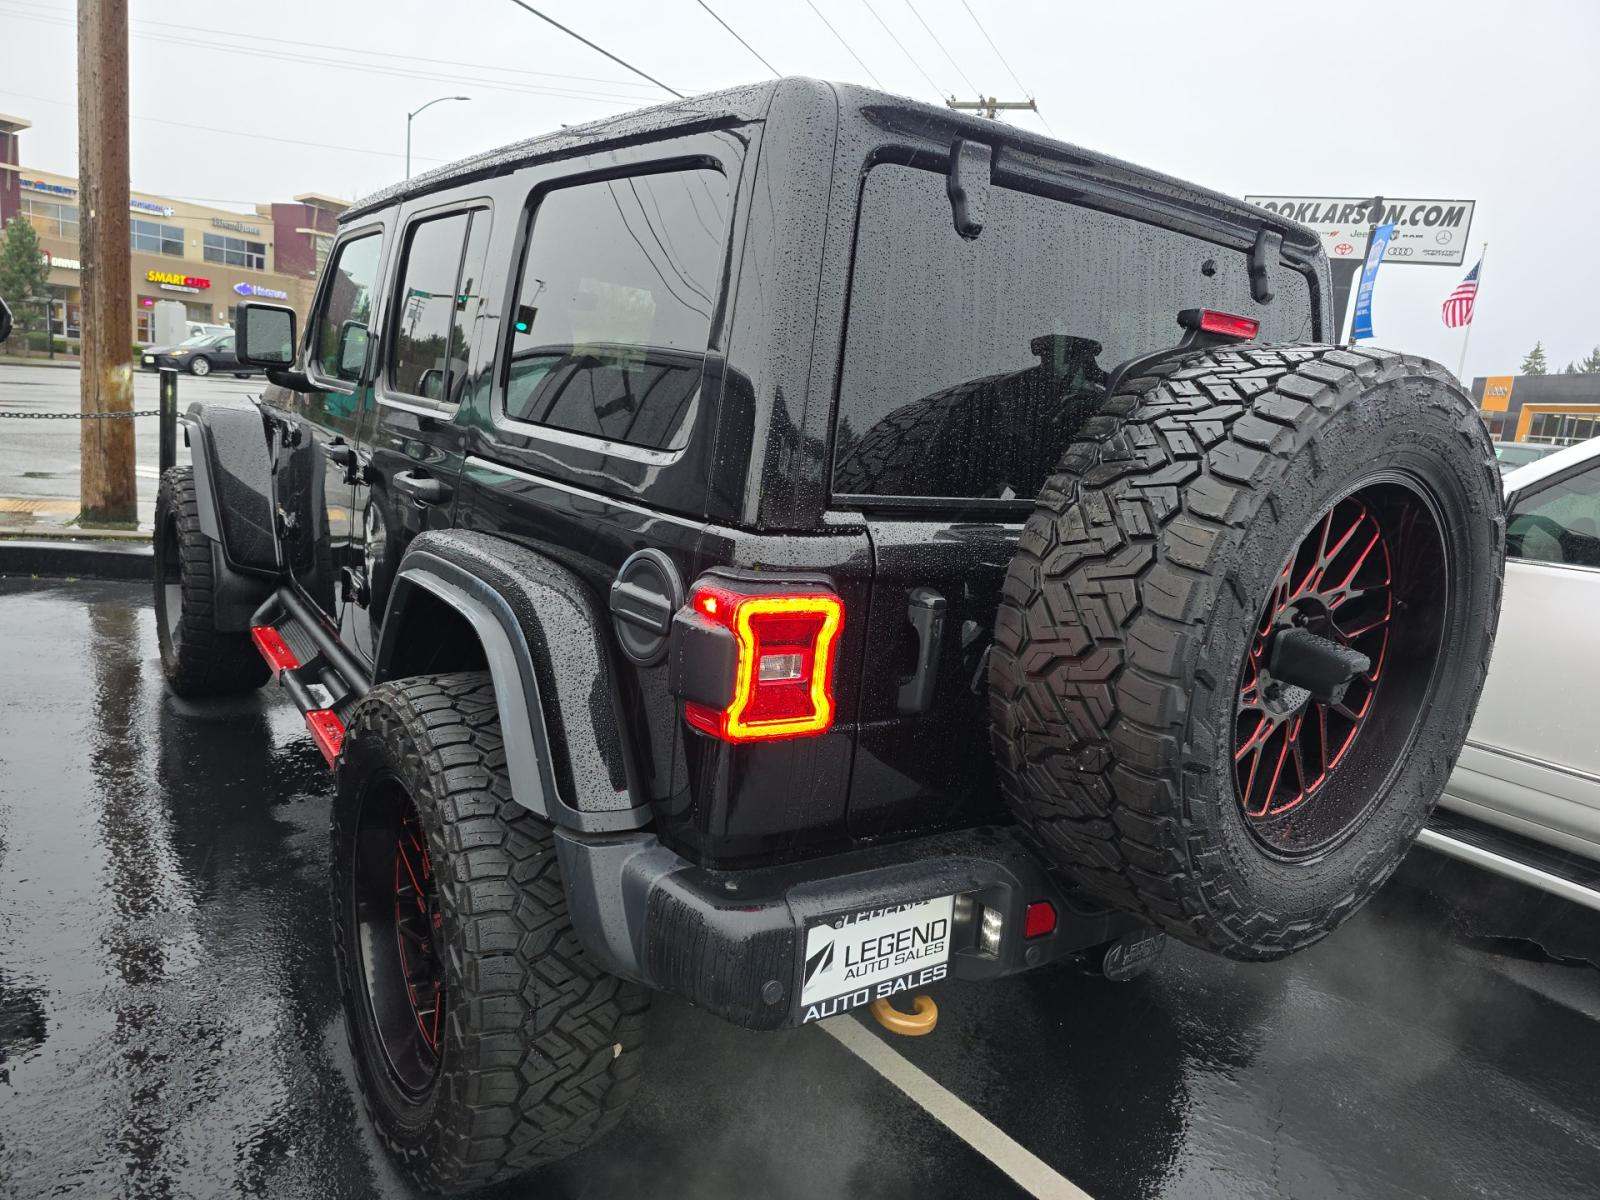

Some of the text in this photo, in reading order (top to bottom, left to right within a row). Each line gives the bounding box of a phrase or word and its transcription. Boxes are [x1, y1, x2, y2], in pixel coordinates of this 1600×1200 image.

[844, 941, 945, 981] AUTO SALES
[845, 918, 948, 968] LEGEND
[803, 963, 948, 1024] AUTO SALES
